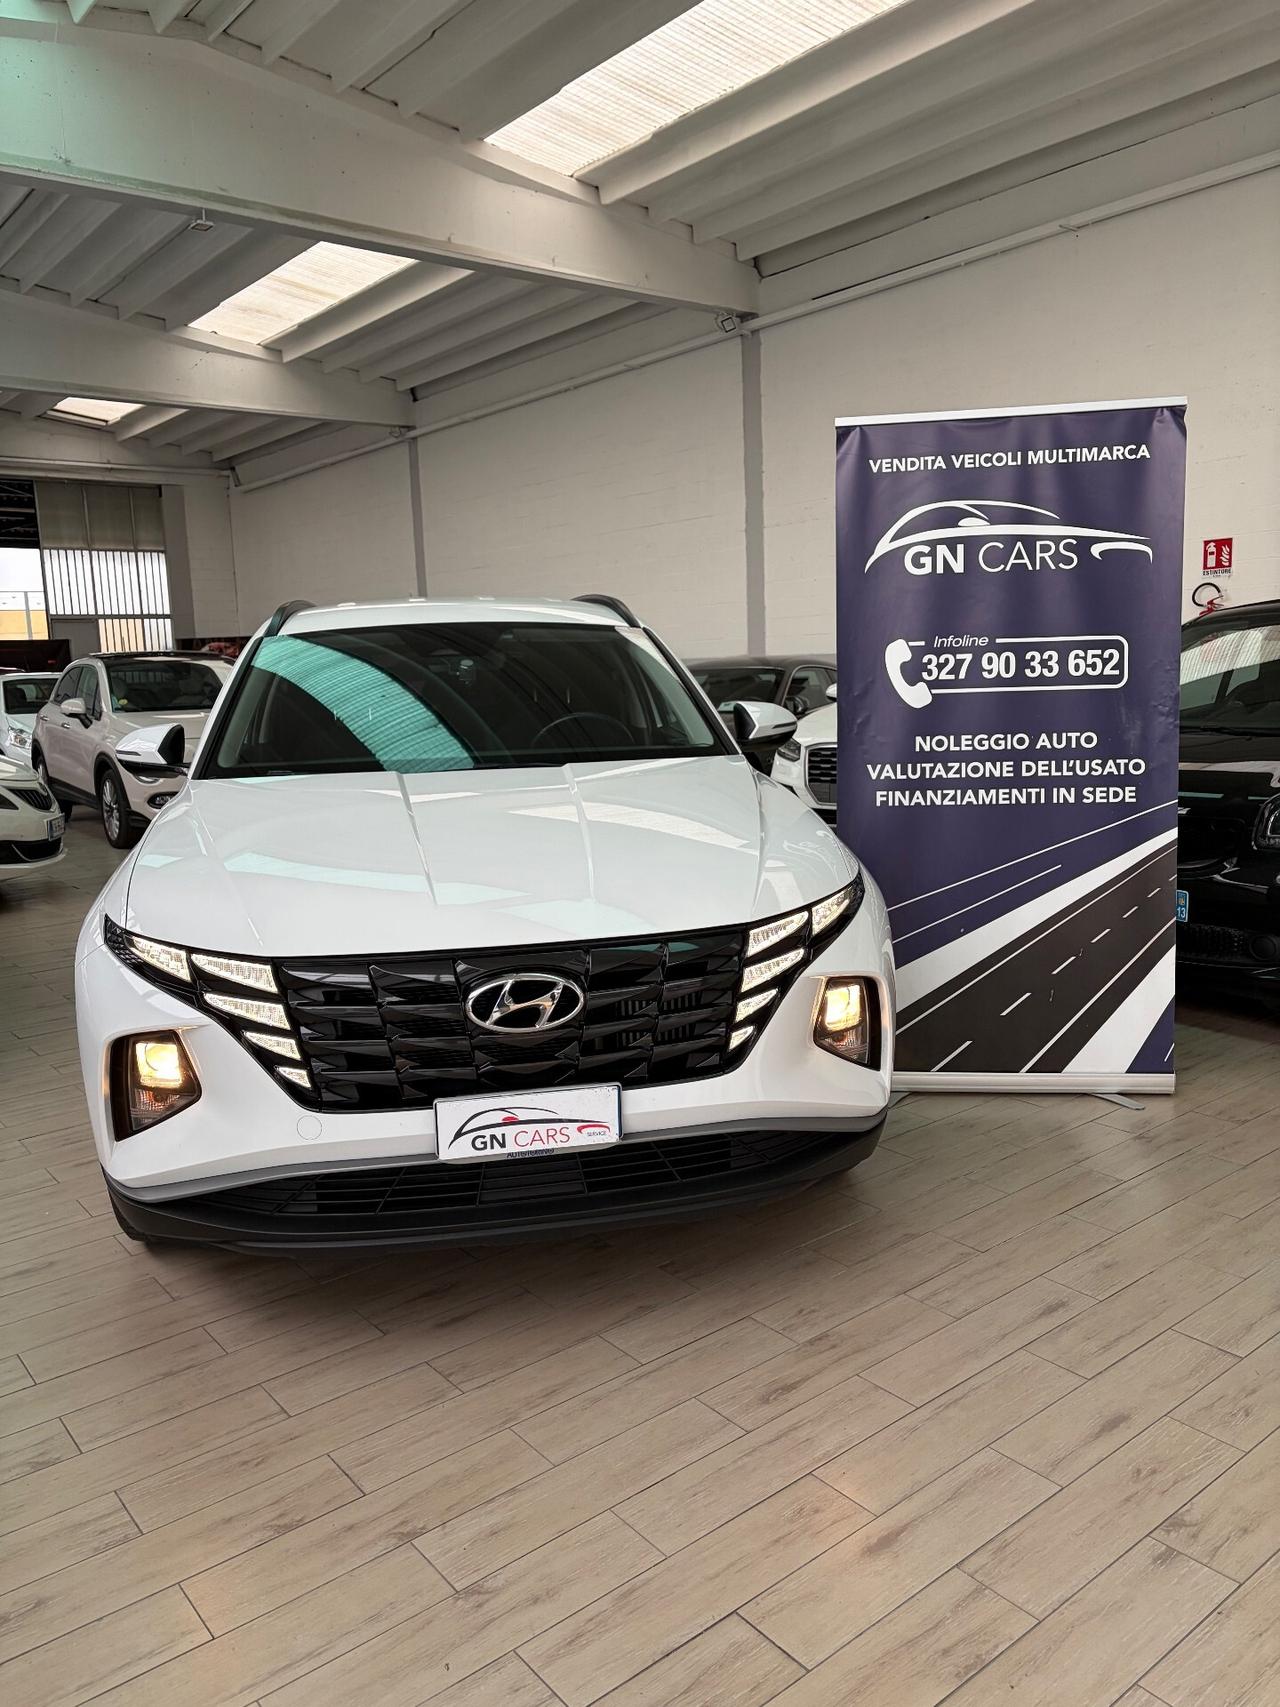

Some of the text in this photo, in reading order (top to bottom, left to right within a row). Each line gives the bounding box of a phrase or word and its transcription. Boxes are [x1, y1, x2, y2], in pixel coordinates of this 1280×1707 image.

[869, 444, 1151, 473] VENDITA VEICOLI MULTIMARCA
[904, 539, 1078, 575] GN CARS
[933, 635, 989, 648] Infoline
[921, 648, 1120, 681] 327 90 33 652
[915, 731, 1098, 752] NOLEGGIO AUTO
[867, 761, 1014, 780] VALUTAZIONE
[875, 786, 1137, 807] FINANZIAMENTI IN SEDE
[471, 1127, 570, 1151] GN CARS
